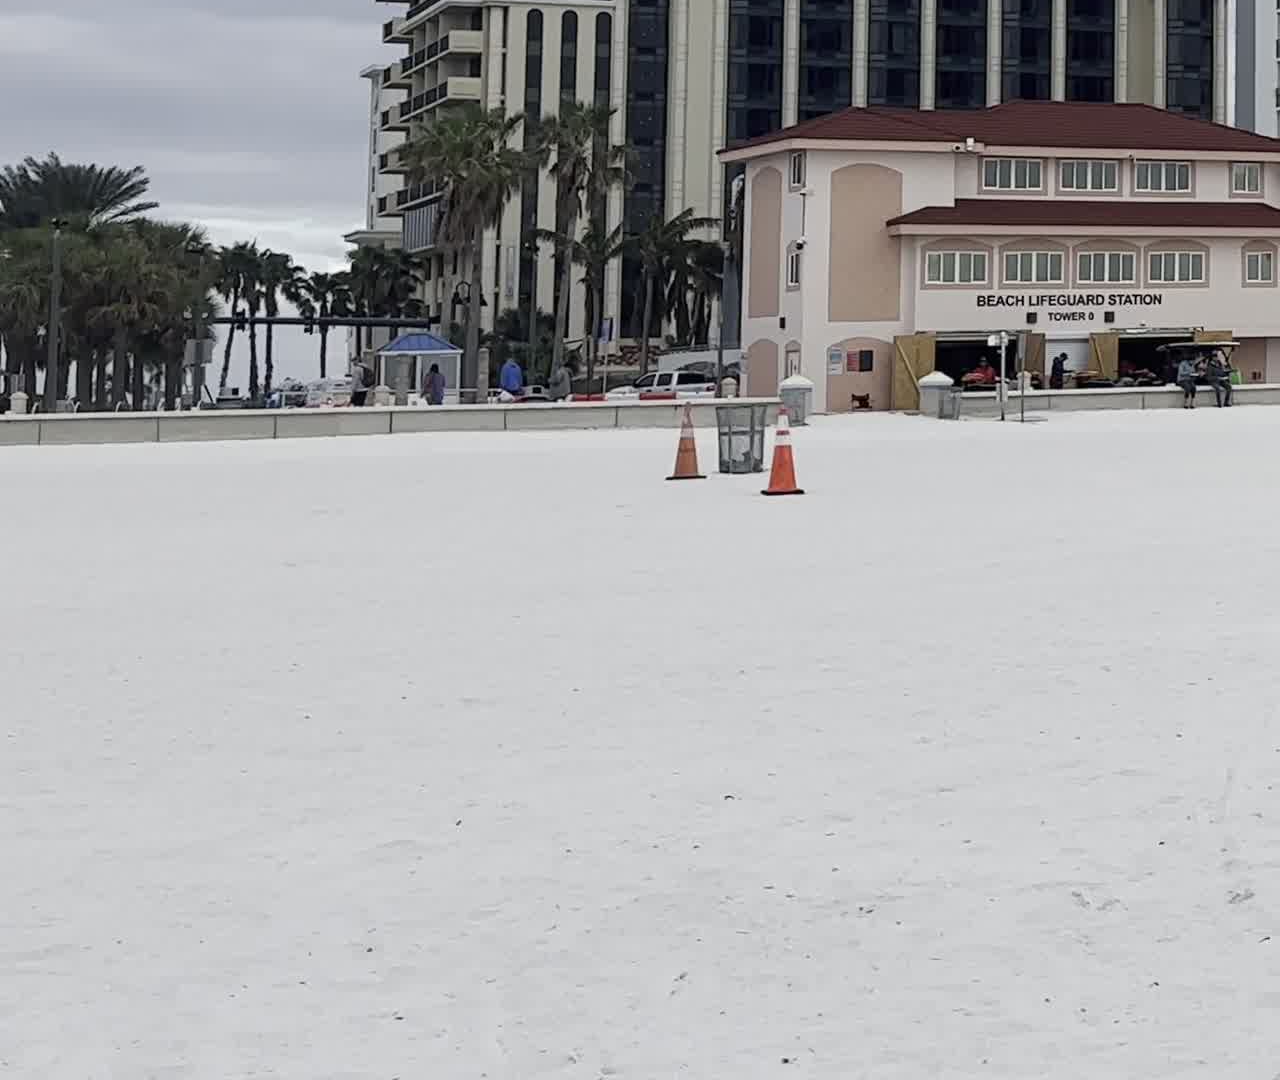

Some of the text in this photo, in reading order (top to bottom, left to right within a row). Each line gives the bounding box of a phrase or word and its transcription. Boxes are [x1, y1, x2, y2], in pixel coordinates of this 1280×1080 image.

[977, 294, 1162, 307] BEACH LIFEGUARD STATION
[1048, 312, 1086, 321] TOWER
